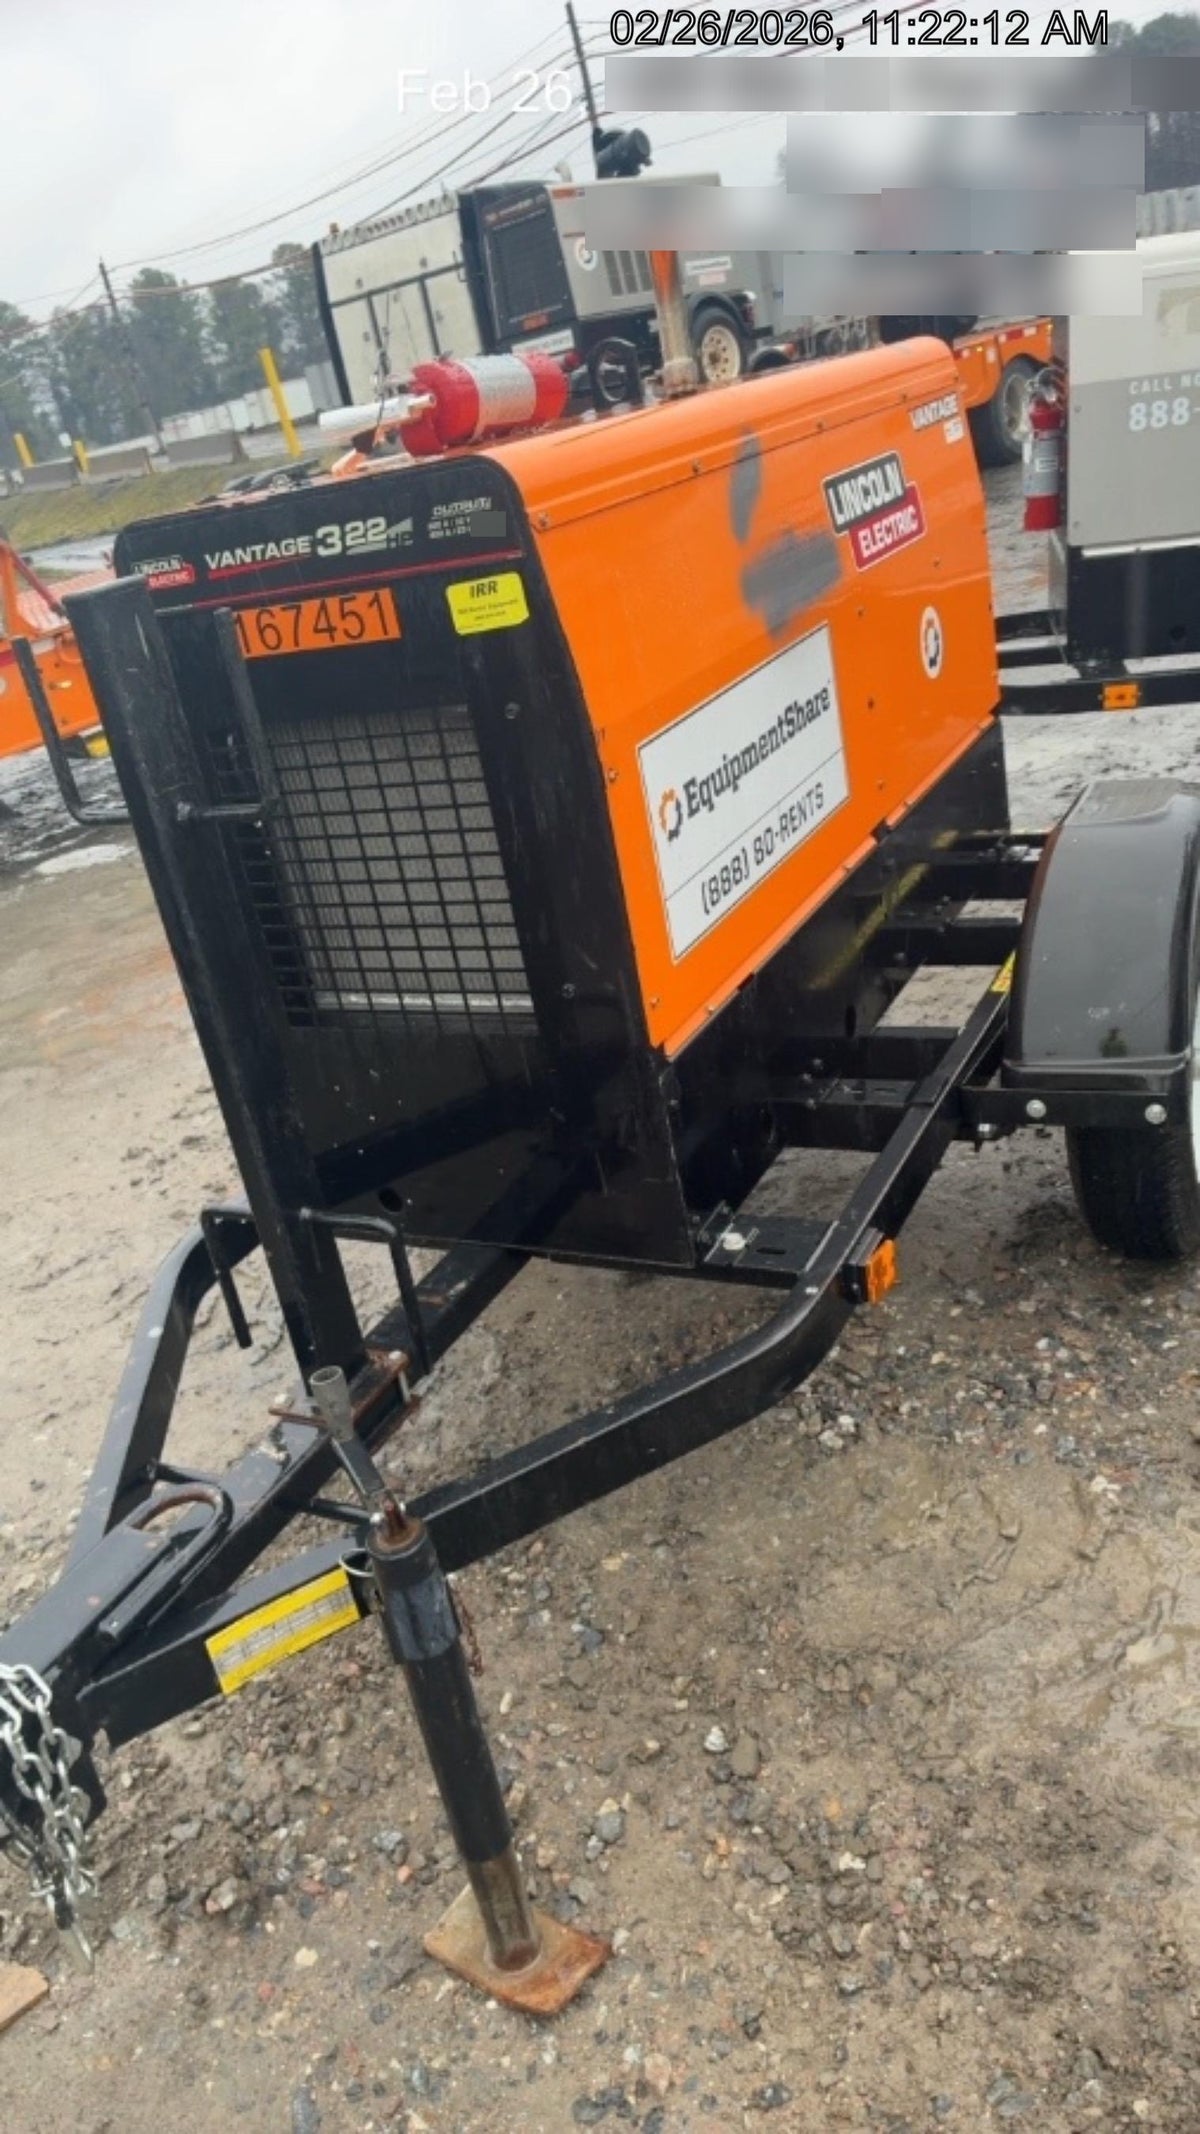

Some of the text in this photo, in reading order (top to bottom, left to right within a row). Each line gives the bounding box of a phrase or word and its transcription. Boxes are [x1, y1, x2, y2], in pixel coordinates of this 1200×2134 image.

[909, 393, 959, 430] VANTAGE
[1128, 376, 1173, 395] CALL
[828, 461, 904, 526] LINCOLN
[204, 535, 313, 570] VANTAGE
[315, 516, 388, 557] 322
[858, 504, 919, 559] ELECTRIC
[469, 580, 499, 599] IRR
[236, 592, 390, 654] 167451
[683, 686, 832, 819] EquipmentShare
[701, 782, 825, 915] (888) 80-RENTS
